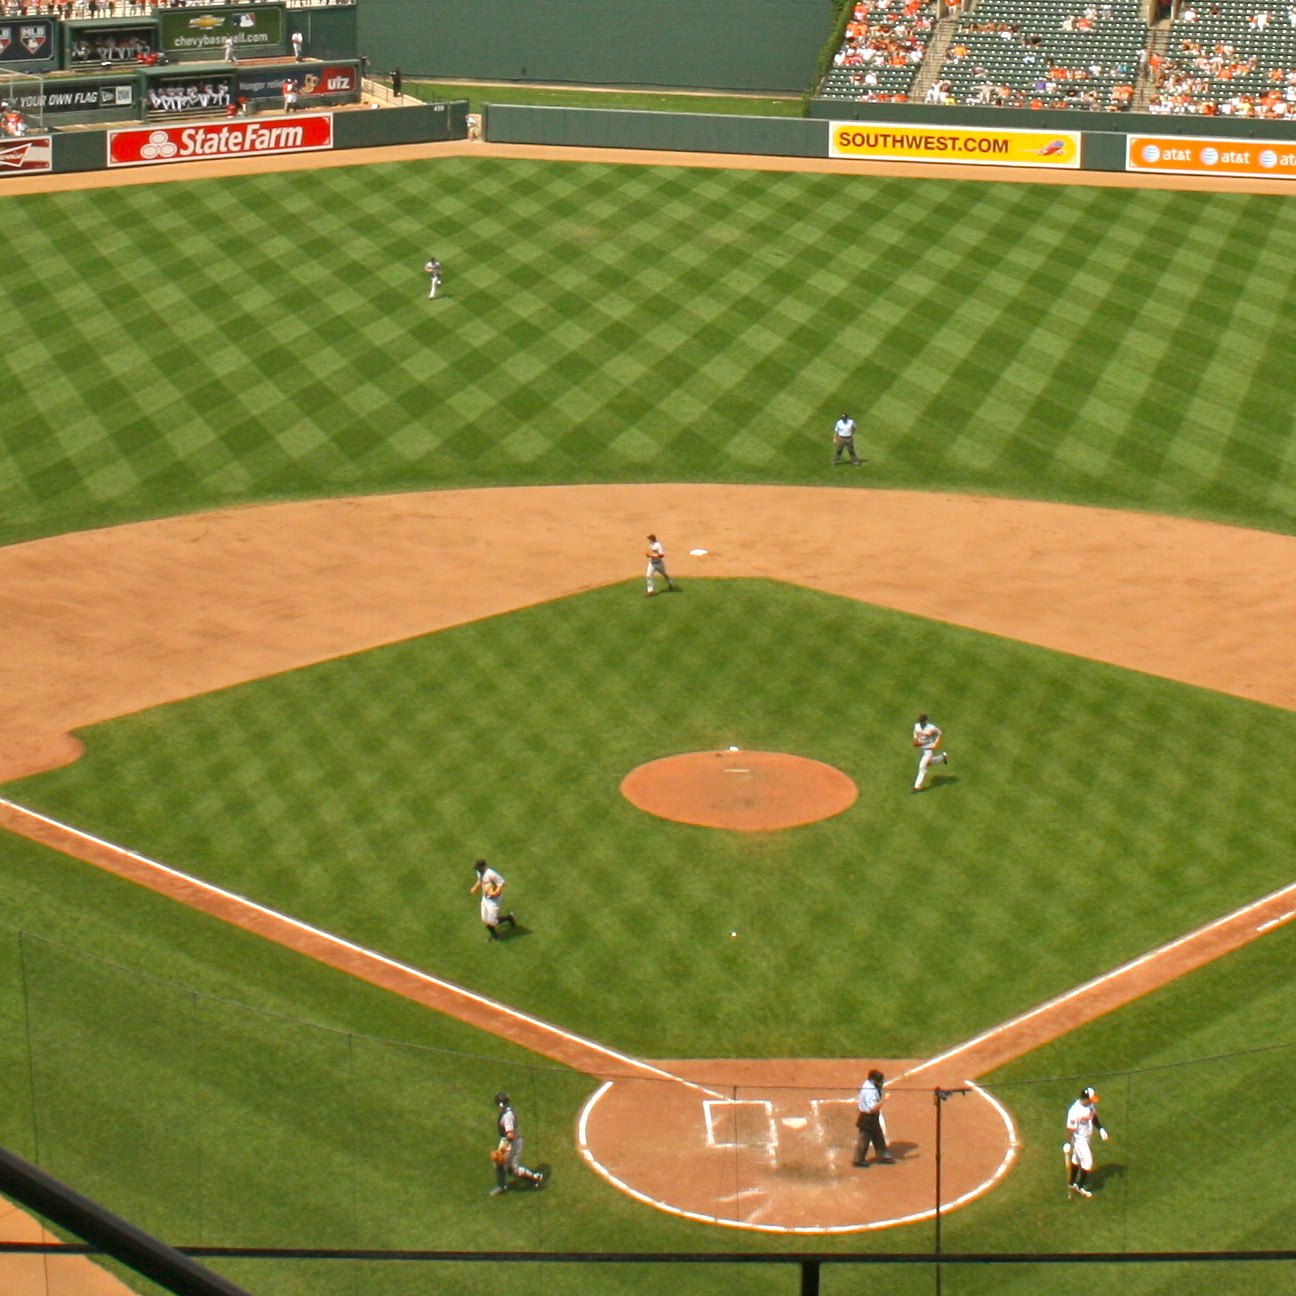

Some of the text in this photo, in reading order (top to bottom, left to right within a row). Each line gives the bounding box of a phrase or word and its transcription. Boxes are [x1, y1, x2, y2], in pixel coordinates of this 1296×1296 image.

[22, 26, 45, 38] MLB
[327, 76, 350, 90] utz
[20, 96, 45, 107] YOUR
[48, 94, 73, 106] OWN
[74, 91, 98, 104] FLAG
[839, 131, 1009, 154] SOUTHWEST.COM
[1162, 148, 1192, 162] at&t
[1221, 150, 1250, 164] at&t
